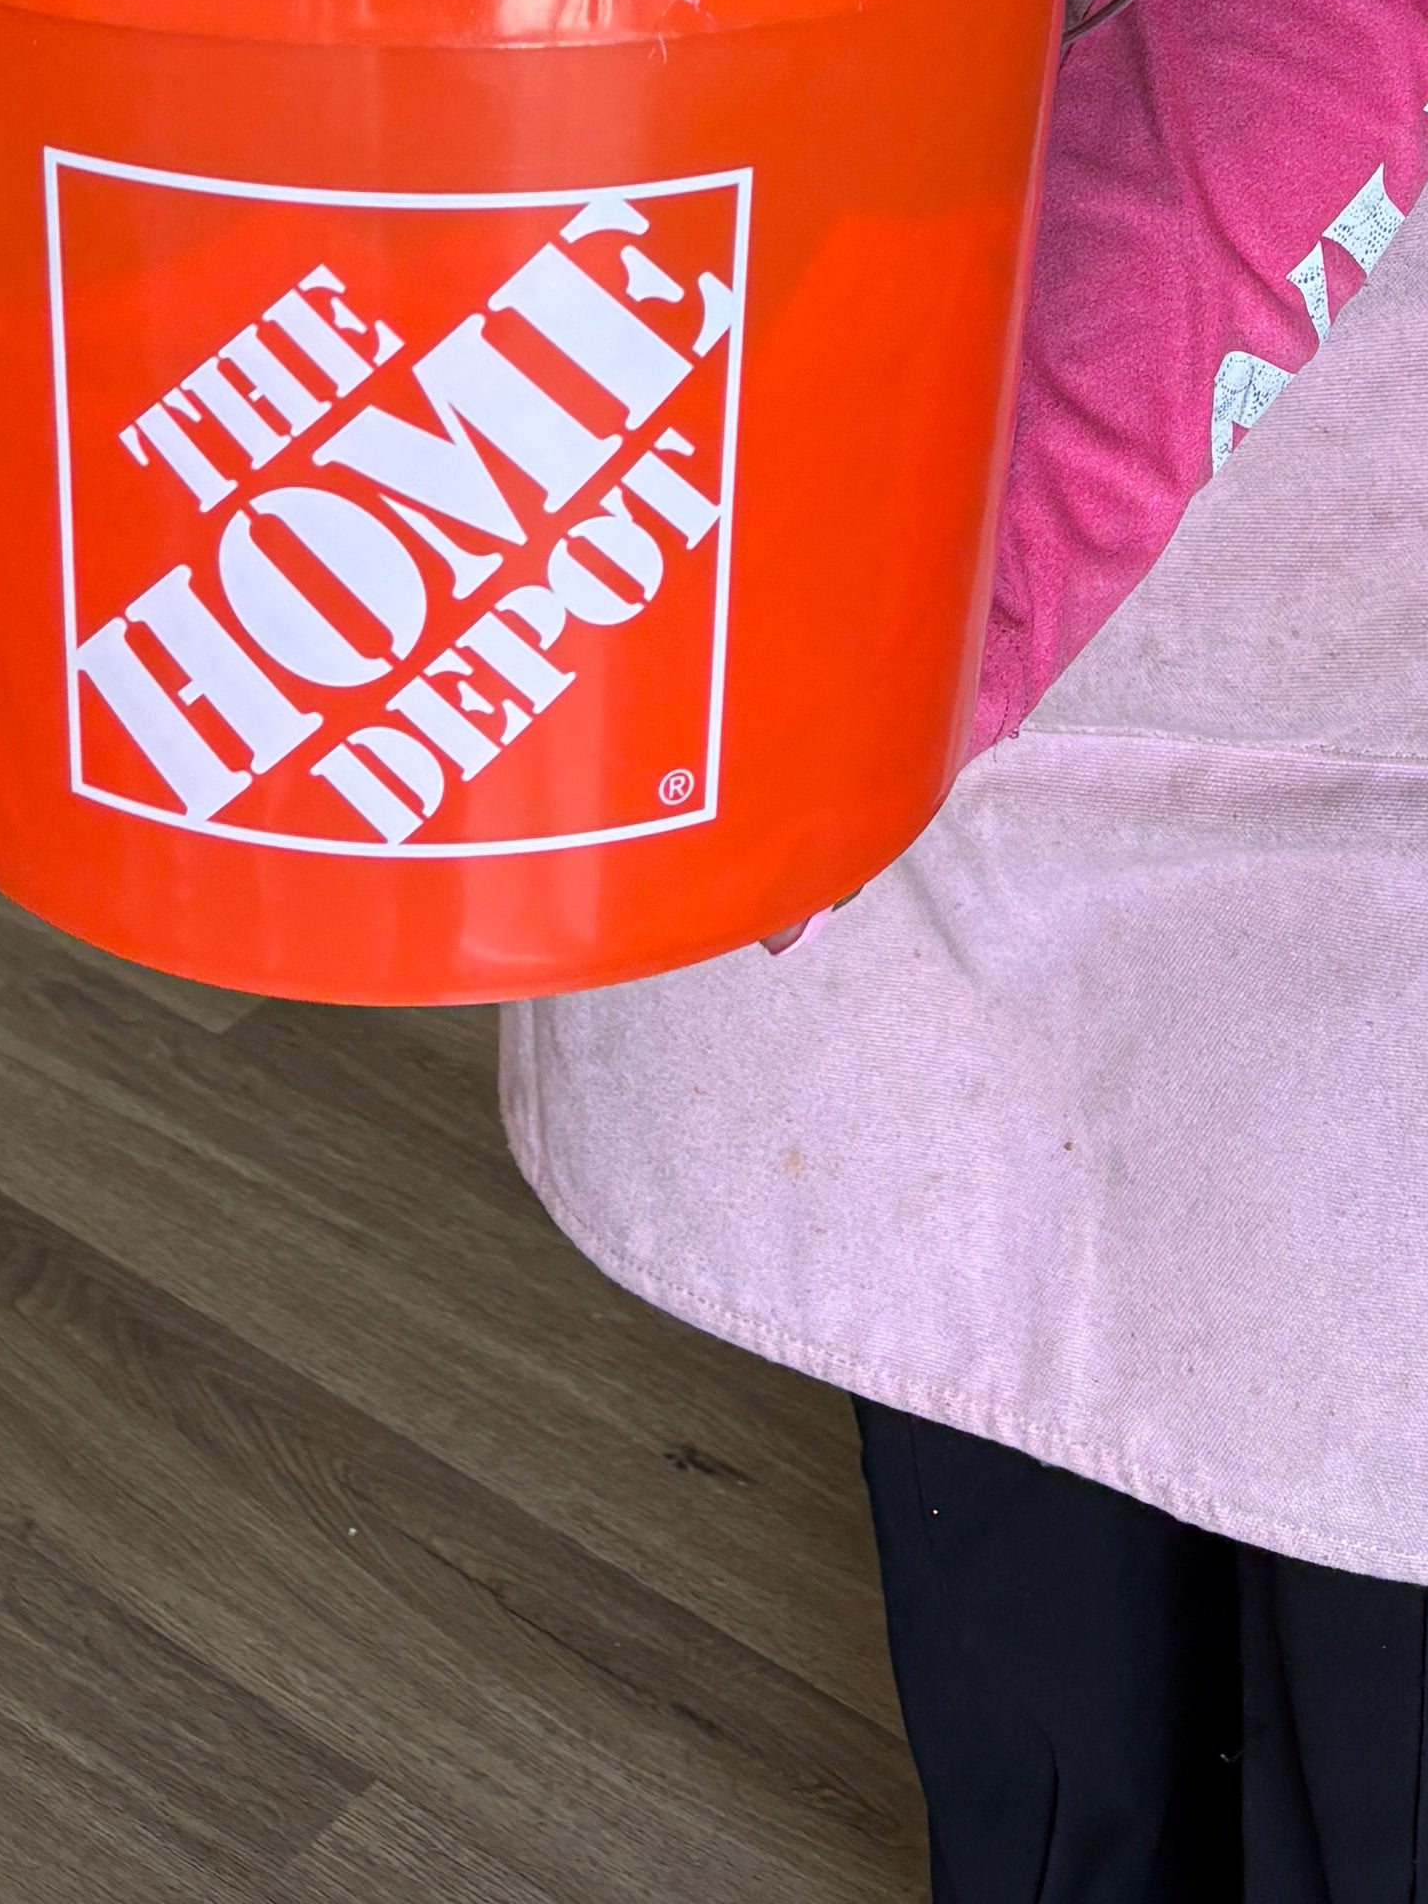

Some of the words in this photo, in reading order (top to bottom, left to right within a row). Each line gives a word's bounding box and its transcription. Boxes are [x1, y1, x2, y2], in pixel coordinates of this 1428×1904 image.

[74, 193, 735, 824] HOME
[118, 263, 405, 514] THE
[309, 426, 722, 848] DEPOT
